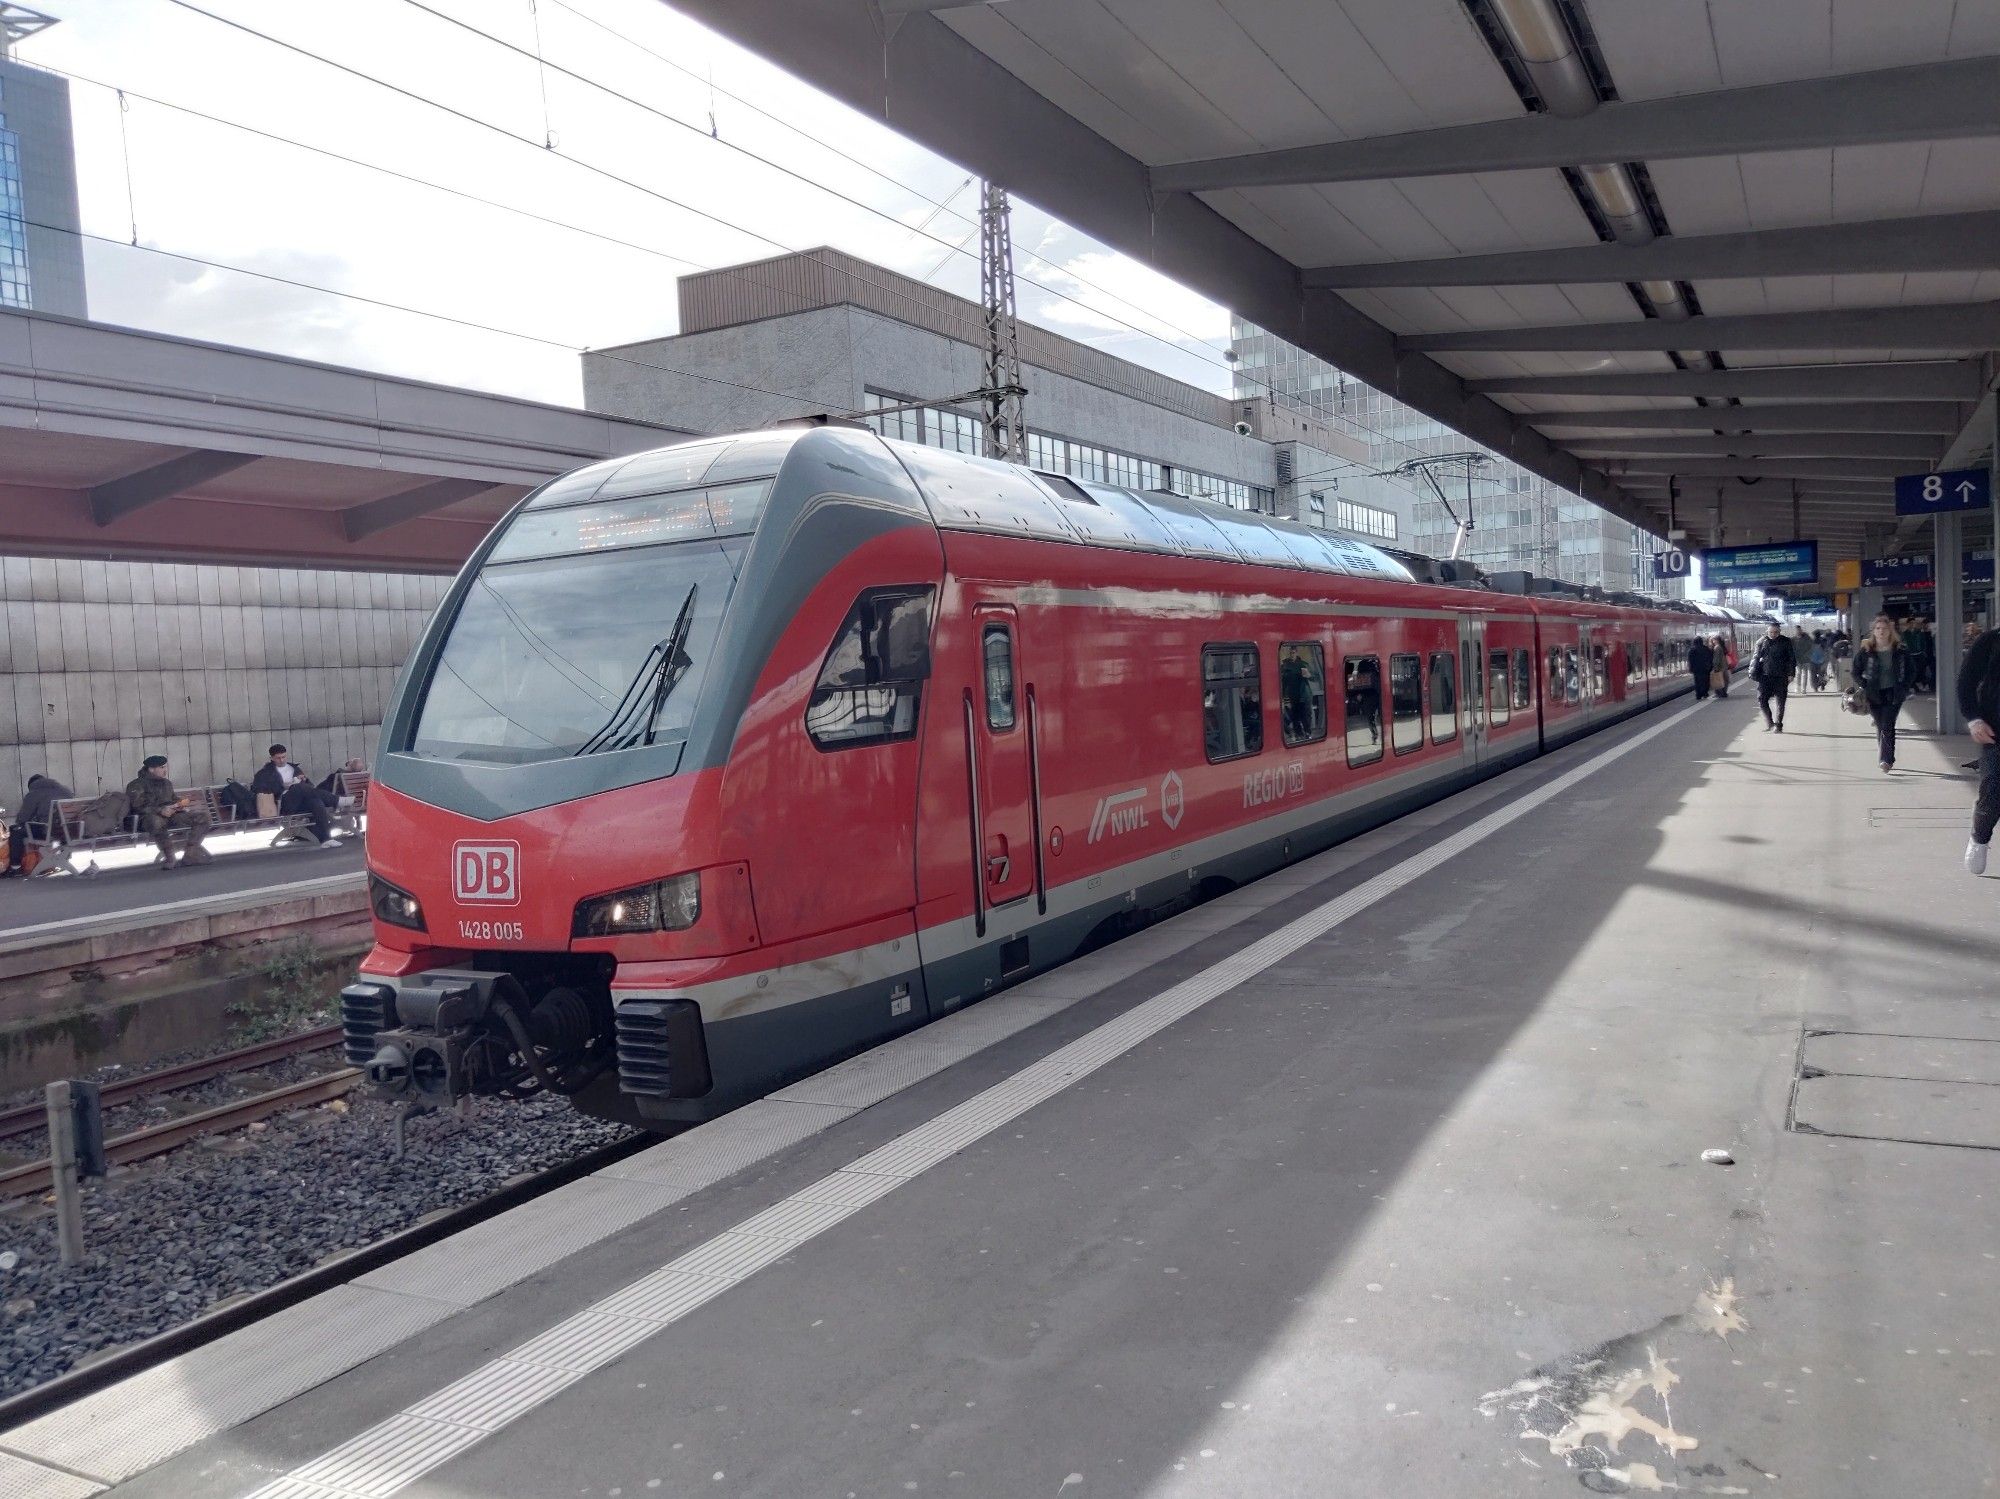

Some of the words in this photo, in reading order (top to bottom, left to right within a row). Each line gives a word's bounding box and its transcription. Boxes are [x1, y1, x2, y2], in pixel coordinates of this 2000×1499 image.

[1922, 475, 1943, 501] 8
[1658, 551, 1684, 573] 10
[1875, 559, 1898, 568] 11-12
[1243, 766, 1285, 808] REGIO
[1111, 804, 1149, 837] NWL
[461, 851, 510, 894] DB
[458, 920, 491, 939] 1428
[494, 922, 523, 940] 005
